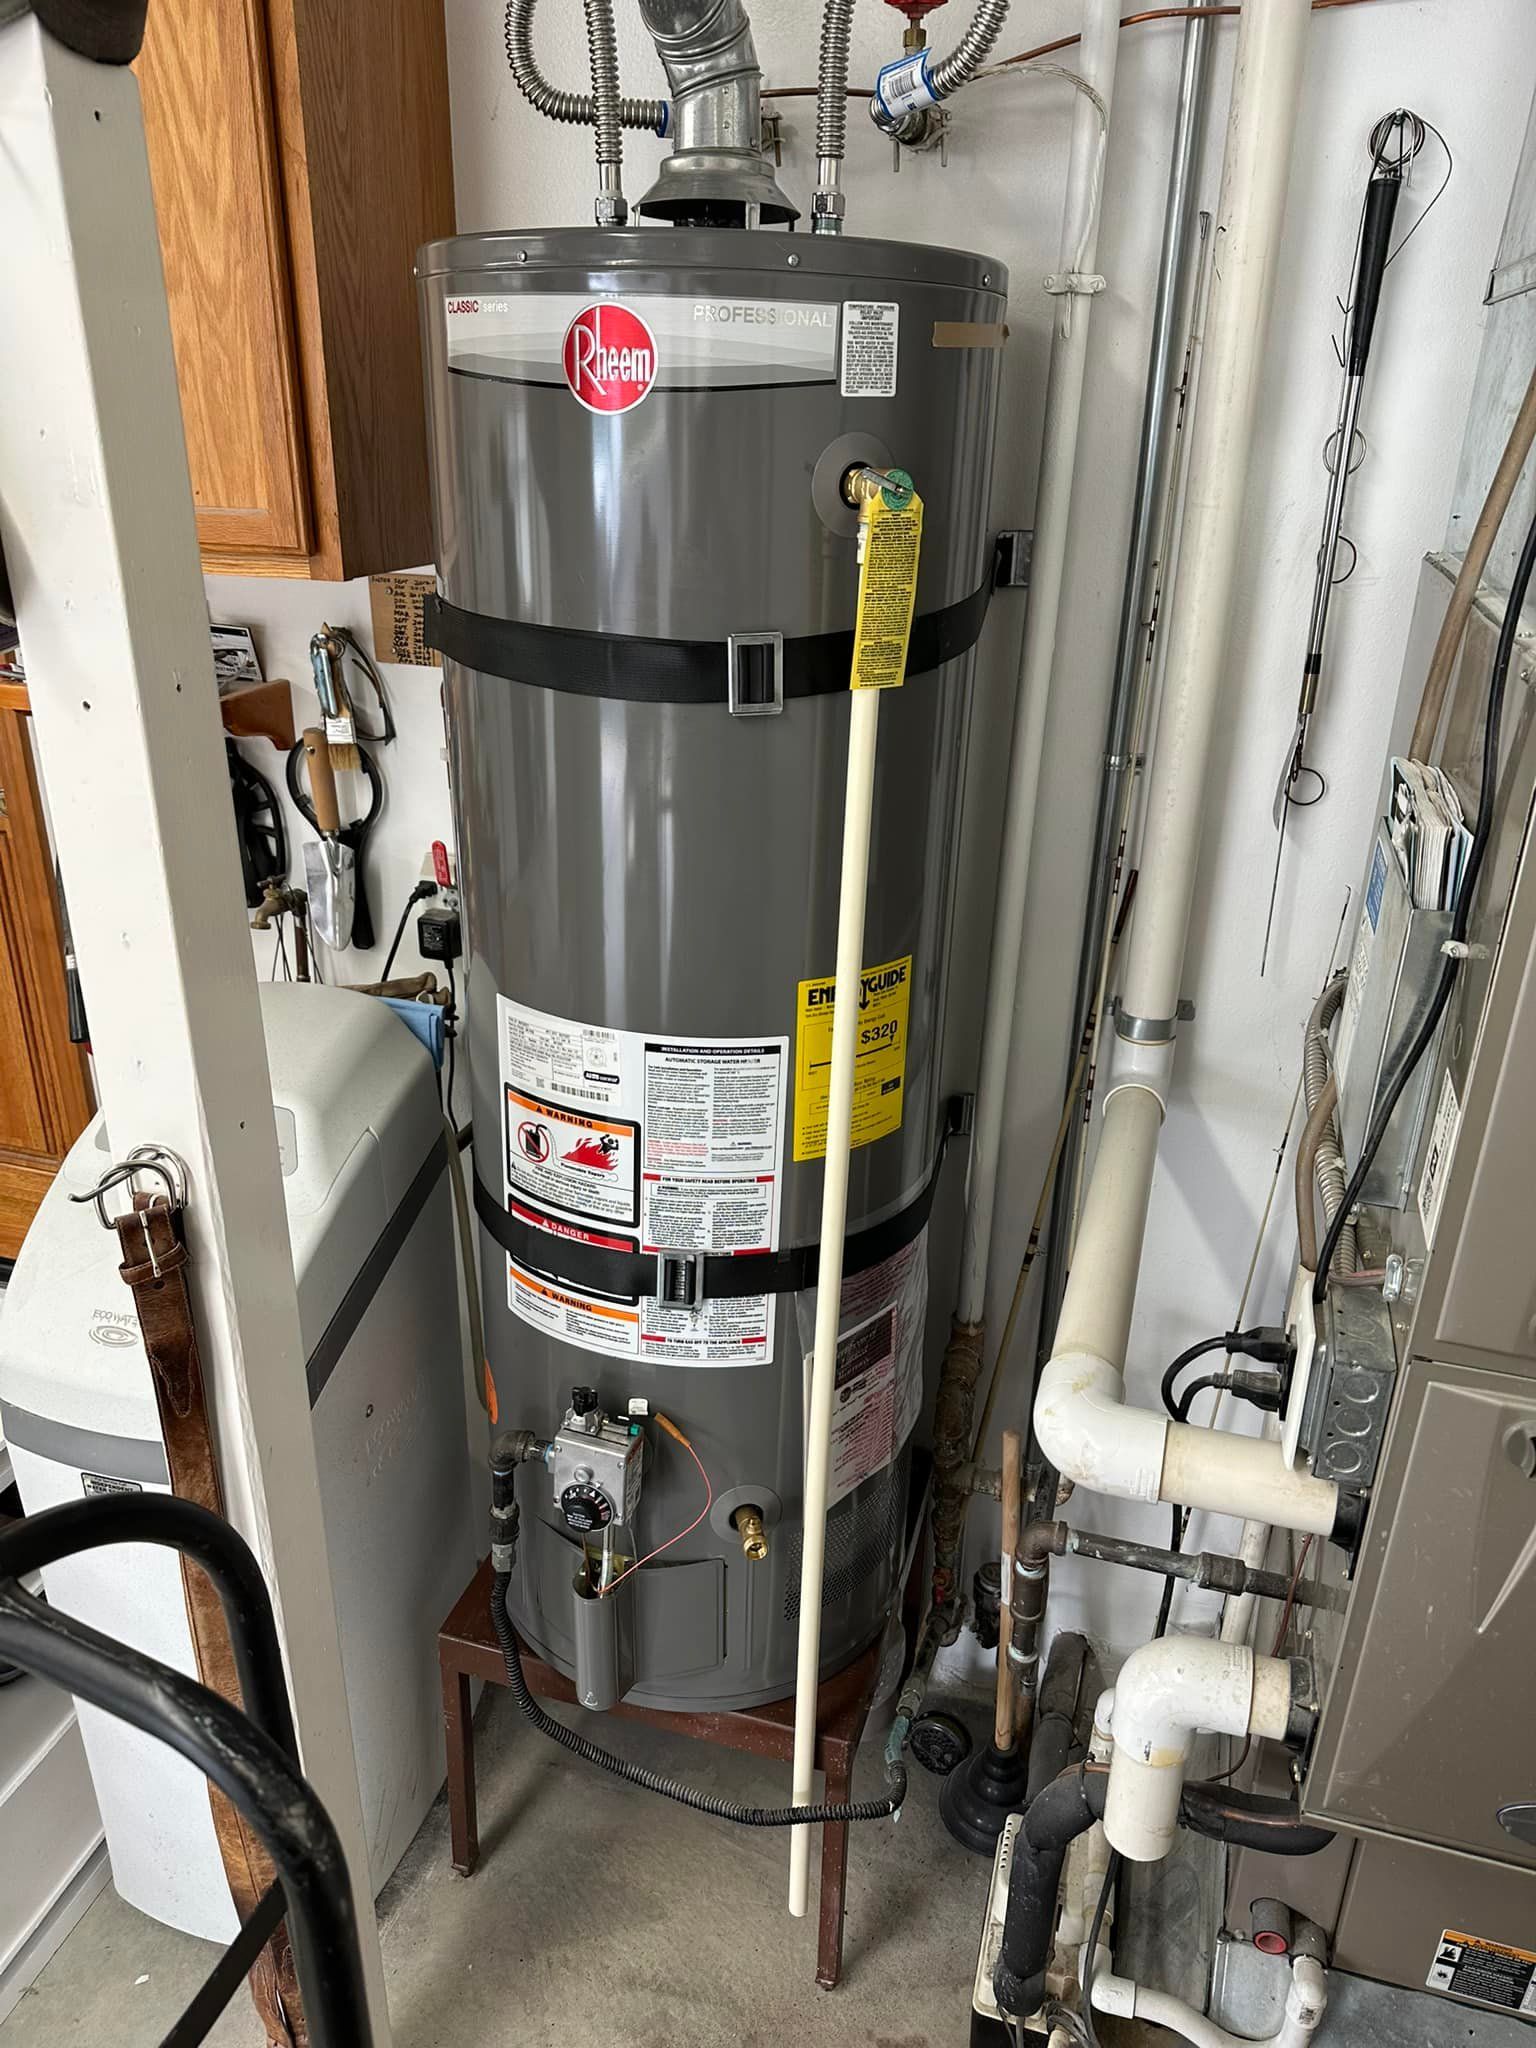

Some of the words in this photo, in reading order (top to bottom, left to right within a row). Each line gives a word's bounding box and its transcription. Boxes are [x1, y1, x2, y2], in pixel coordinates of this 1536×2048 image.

[448, 300, 479, 314] CLASSIC
[482, 301, 511, 313] series
[693, 304, 833, 328] PROFESSIONAL
[574, 306, 651, 396] Rheem
[808, 965, 906, 1009] ENYGUIDE
[860, 1019, 898, 1044] $320
[546, 1109, 593, 1129] WARNING
[551, 1222, 590, 1241] DANGER
[551, 1290, 593, 1312] WARNING
[92, 1309, 138, 1327] ECOWATE
